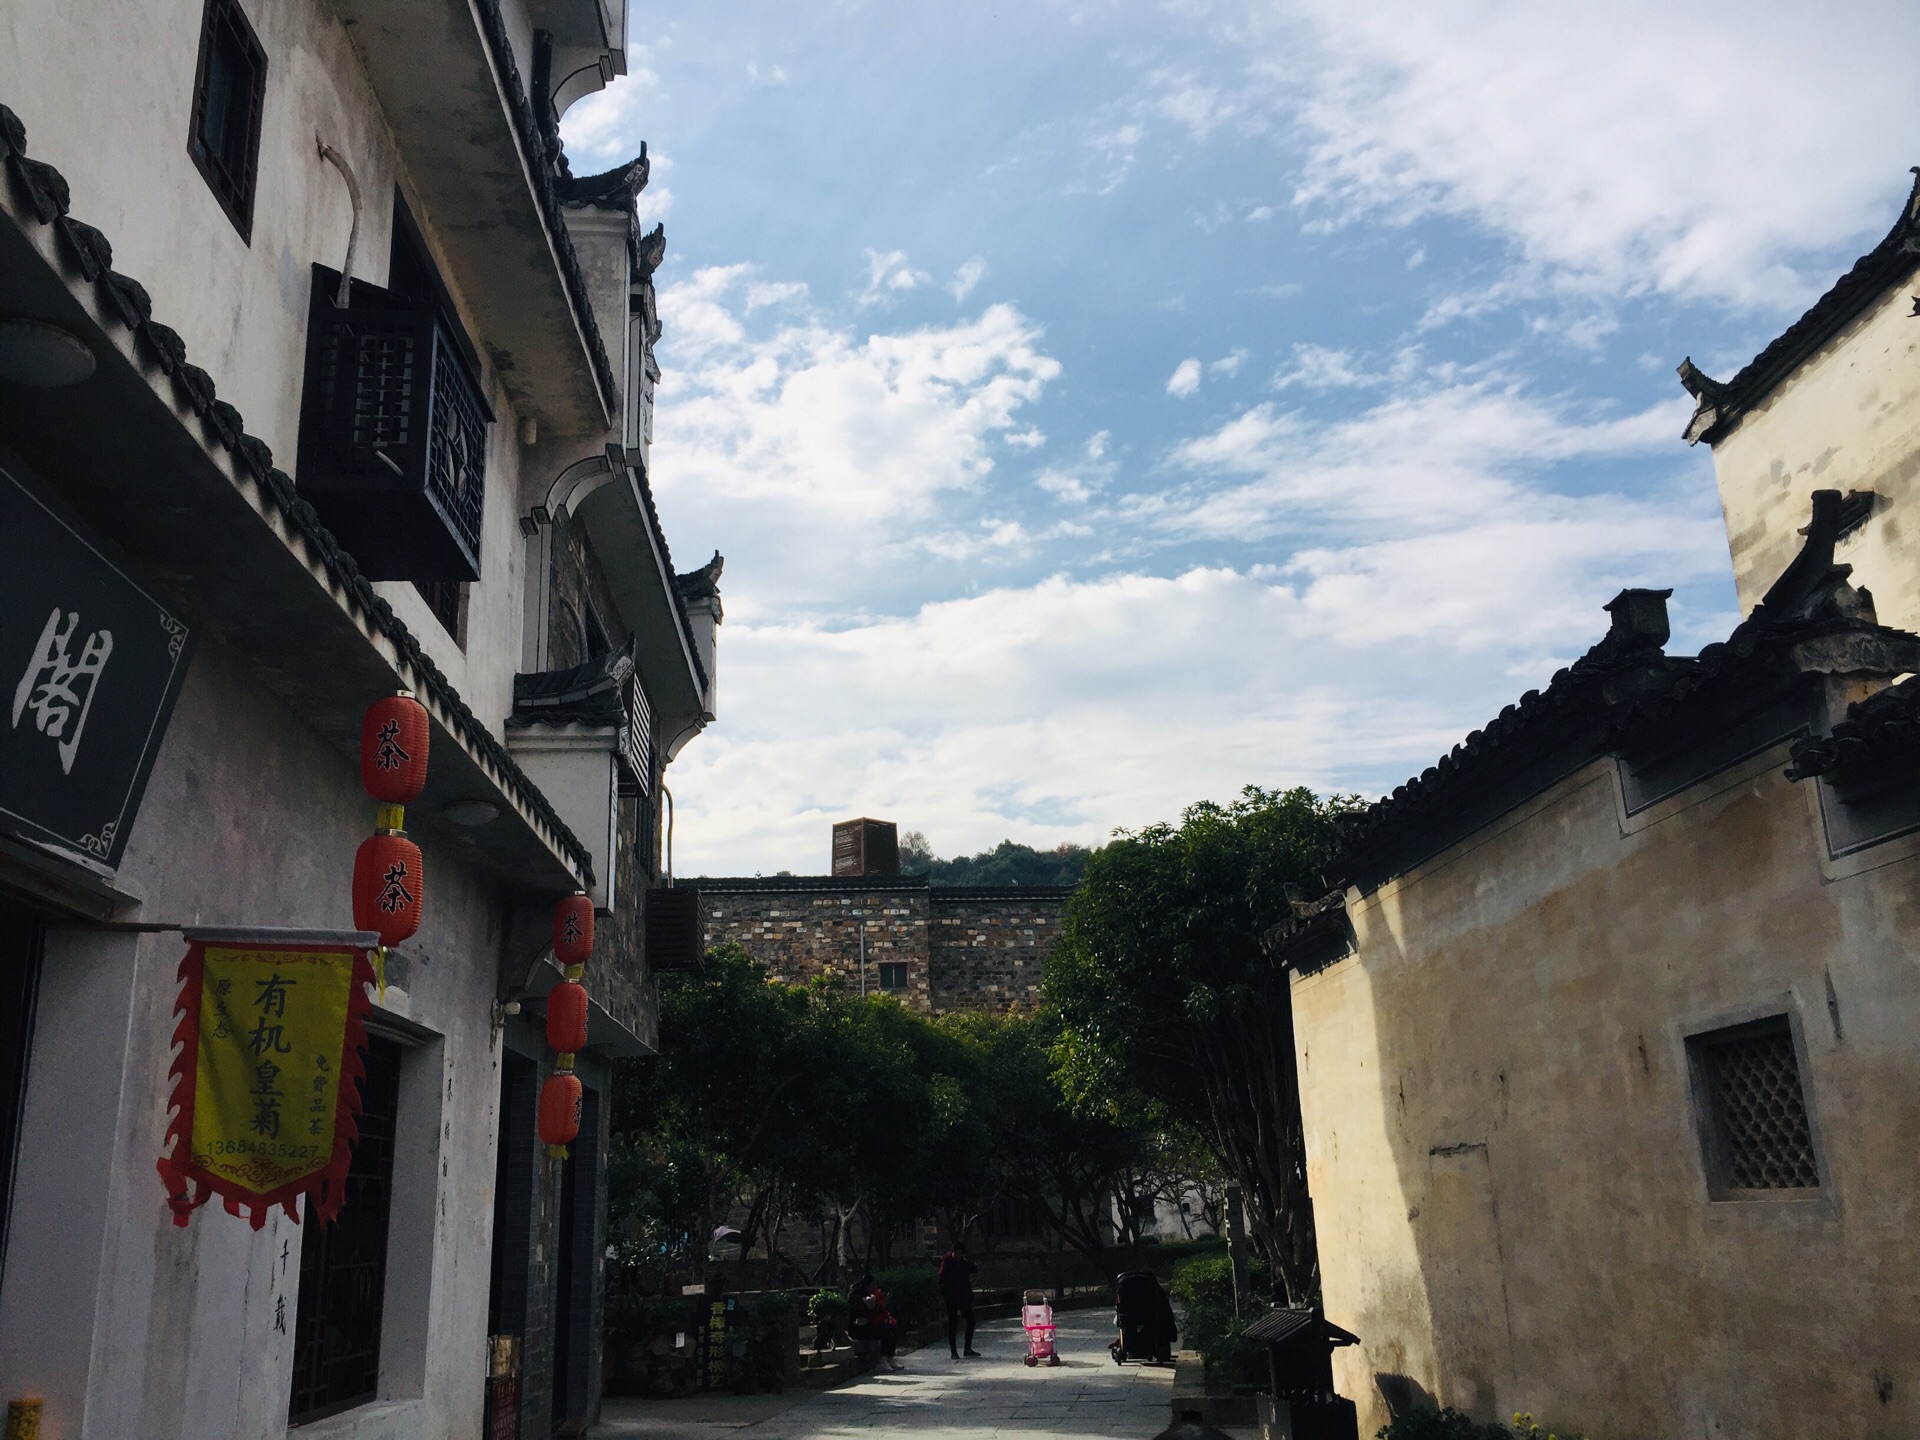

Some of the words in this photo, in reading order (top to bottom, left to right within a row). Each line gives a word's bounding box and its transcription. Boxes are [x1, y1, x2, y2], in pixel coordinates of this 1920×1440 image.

[12, 607, 113, 776] 閣
[372, 719, 411, 771] 茶
[376, 861, 414, 914] 茶
[561, 911, 583, 945] 茶
[212, 979, 232, 1038] 原生态
[248, 974, 296, 1140] 有机皇菊
[207, 1140, 319, 1157] 13684835227
